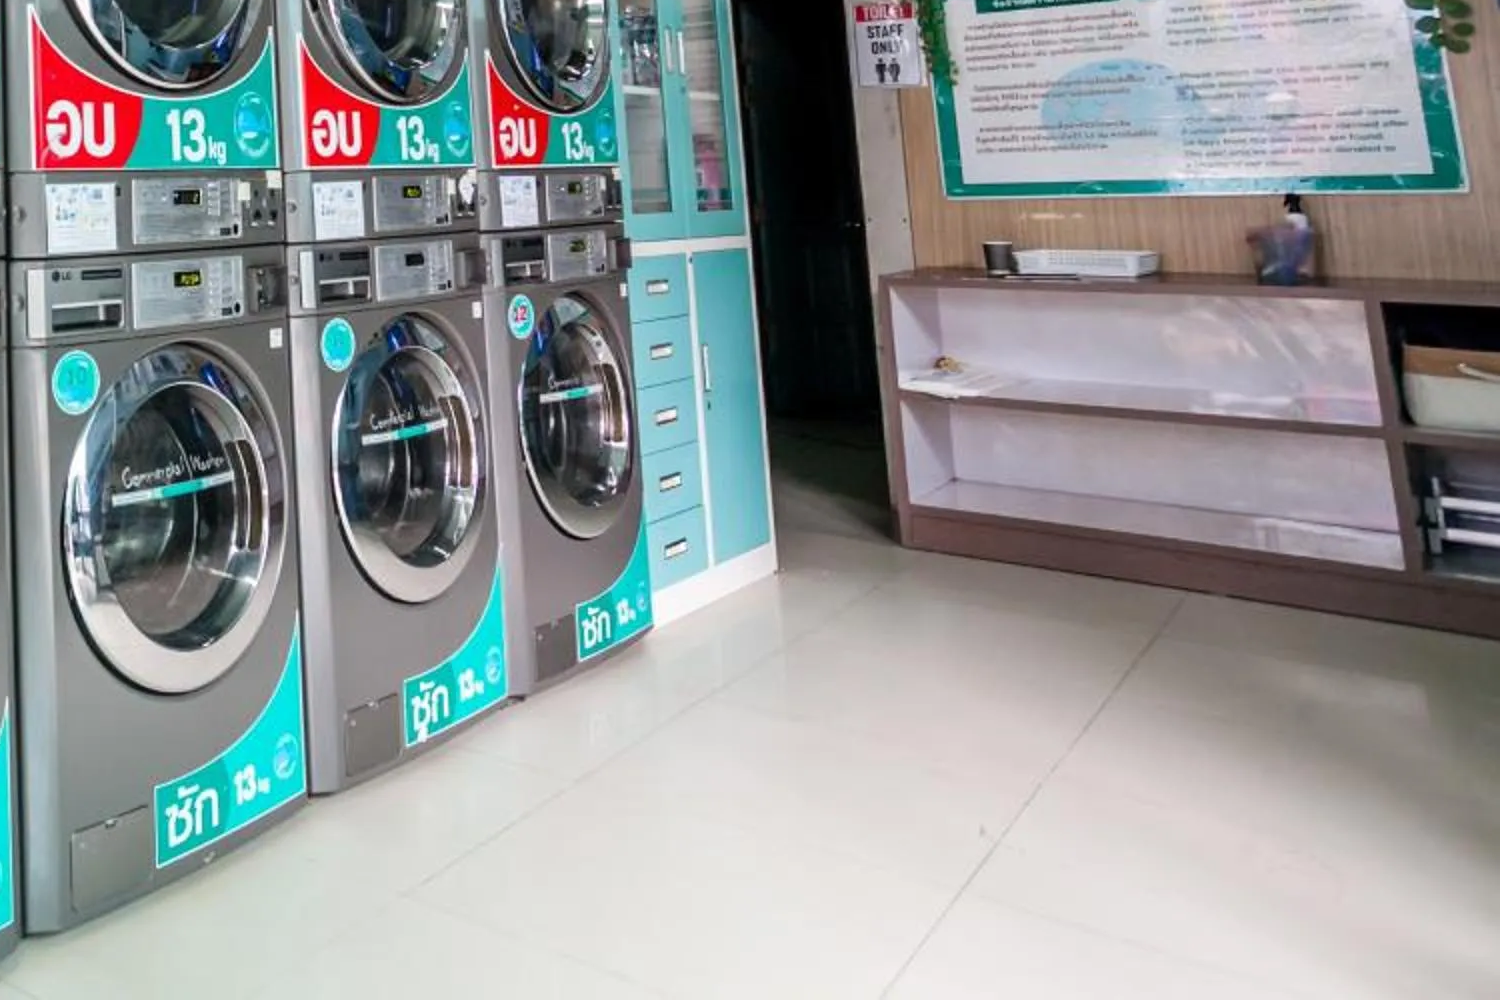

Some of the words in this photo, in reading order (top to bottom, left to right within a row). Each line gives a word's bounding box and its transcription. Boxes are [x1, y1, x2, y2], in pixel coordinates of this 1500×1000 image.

[866, 23, 905, 39] STAFF
[45, 99, 116, 159] อบ
[165, 108, 208, 162] 13
[208, 135, 227, 166] kg
[311, 109, 362, 158] อบ
[396, 115, 425, 161] 13
[498, 116, 538, 159] อบ
[560, 121, 584, 160] 13
[233, 763, 257, 805] 13
